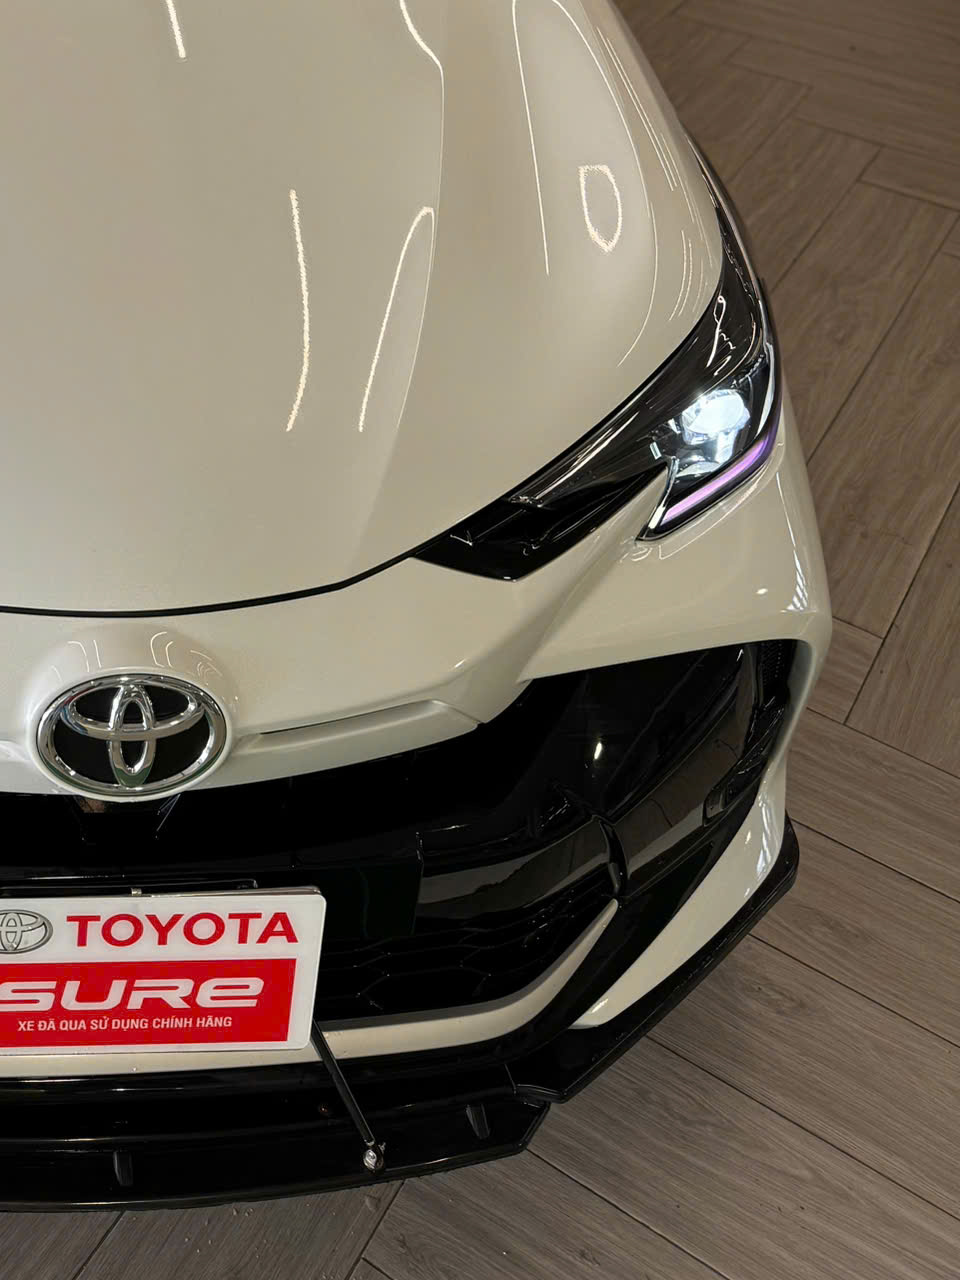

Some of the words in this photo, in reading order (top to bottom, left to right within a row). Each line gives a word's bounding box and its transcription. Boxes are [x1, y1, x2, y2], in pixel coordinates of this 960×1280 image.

[66, 911, 299, 948] TOYOTA
[17, 1020, 35, 1032] XE
[37, 1017, 57, 1031] ĐÃ
[59, 1019, 87, 1031] QUA
[90, 1016, 110, 1030] SỬ
[112, 1018, 149, 1032] DỤNG
[152, 1015, 192, 1030] CHÍNH
